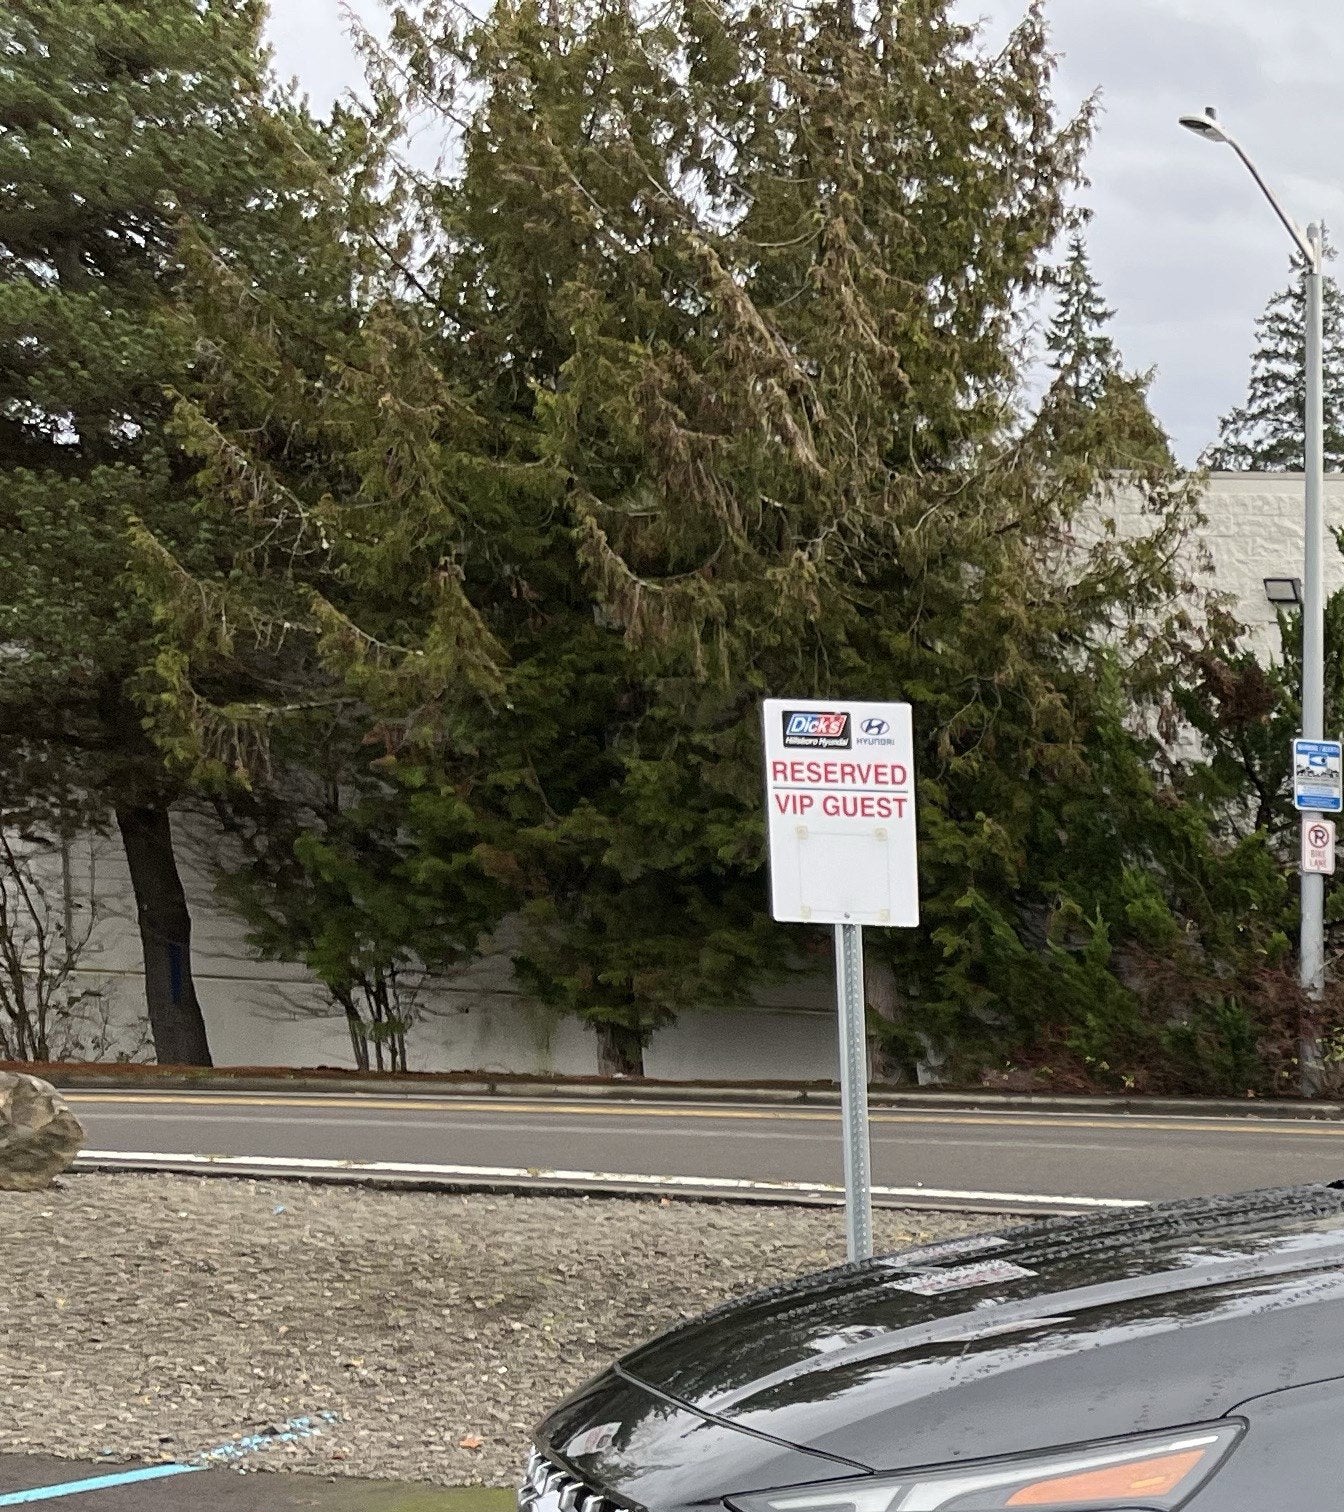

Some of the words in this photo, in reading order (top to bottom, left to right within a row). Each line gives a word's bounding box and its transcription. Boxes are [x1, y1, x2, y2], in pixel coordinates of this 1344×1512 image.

[856, 737, 895, 746] HYUNDAI
[772, 761, 908, 786] RESERVED
[775, 793, 814, 816] VIP
[822, 795, 908, 819] GUEST
